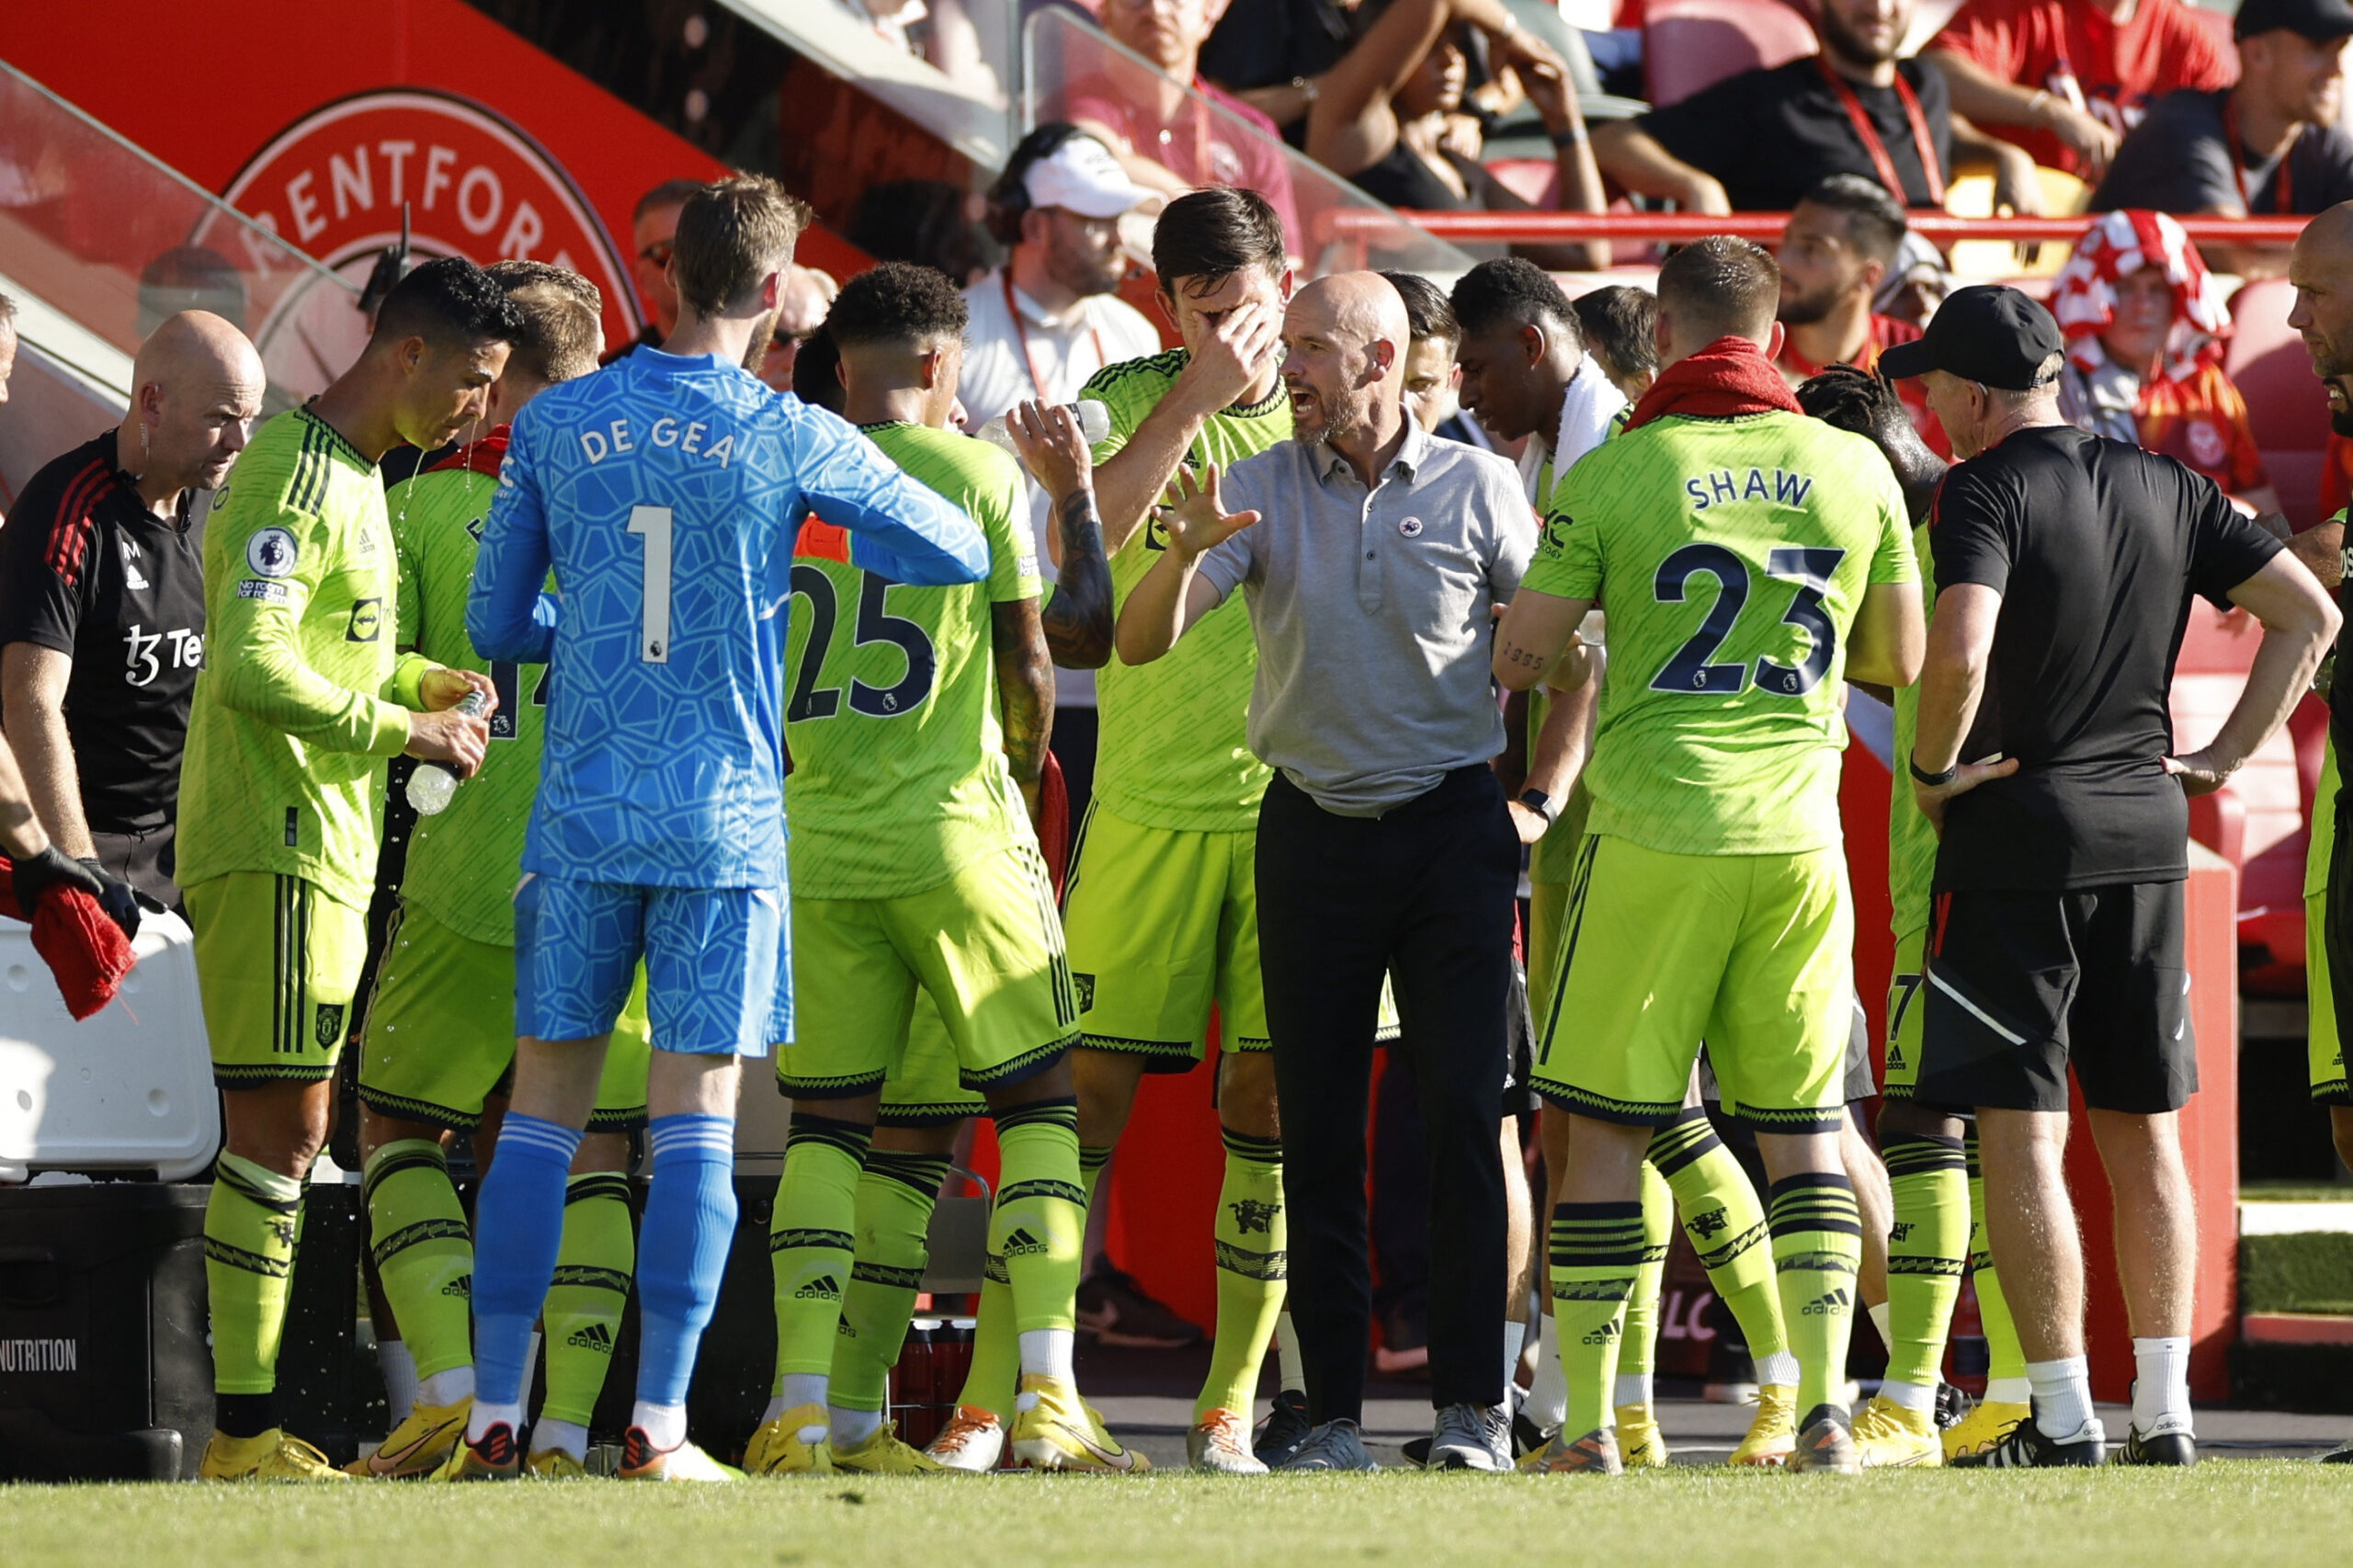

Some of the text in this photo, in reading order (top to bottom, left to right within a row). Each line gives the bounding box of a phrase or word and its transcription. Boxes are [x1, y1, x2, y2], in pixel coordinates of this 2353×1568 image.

[240, 141, 577, 280] RENTFOR
[580, 417, 734, 470] DE GEA
[1686, 468, 1812, 509] SHAW
[239, 581, 284, 595] No room
[626, 505, 672, 664] 1
[784, 563, 937, 723] 25
[1650, 542, 1847, 697] 23
[1887, 973, 1924, 1042] 7
[794, 1289, 842, 1303] adidas
[1659, 1290, 1717, 1341] LC
[0, 1338, 76, 1372] NUTRITION
[567, 1335, 613, 1356] adidas
[2156, 1420, 2184, 1431] adida
